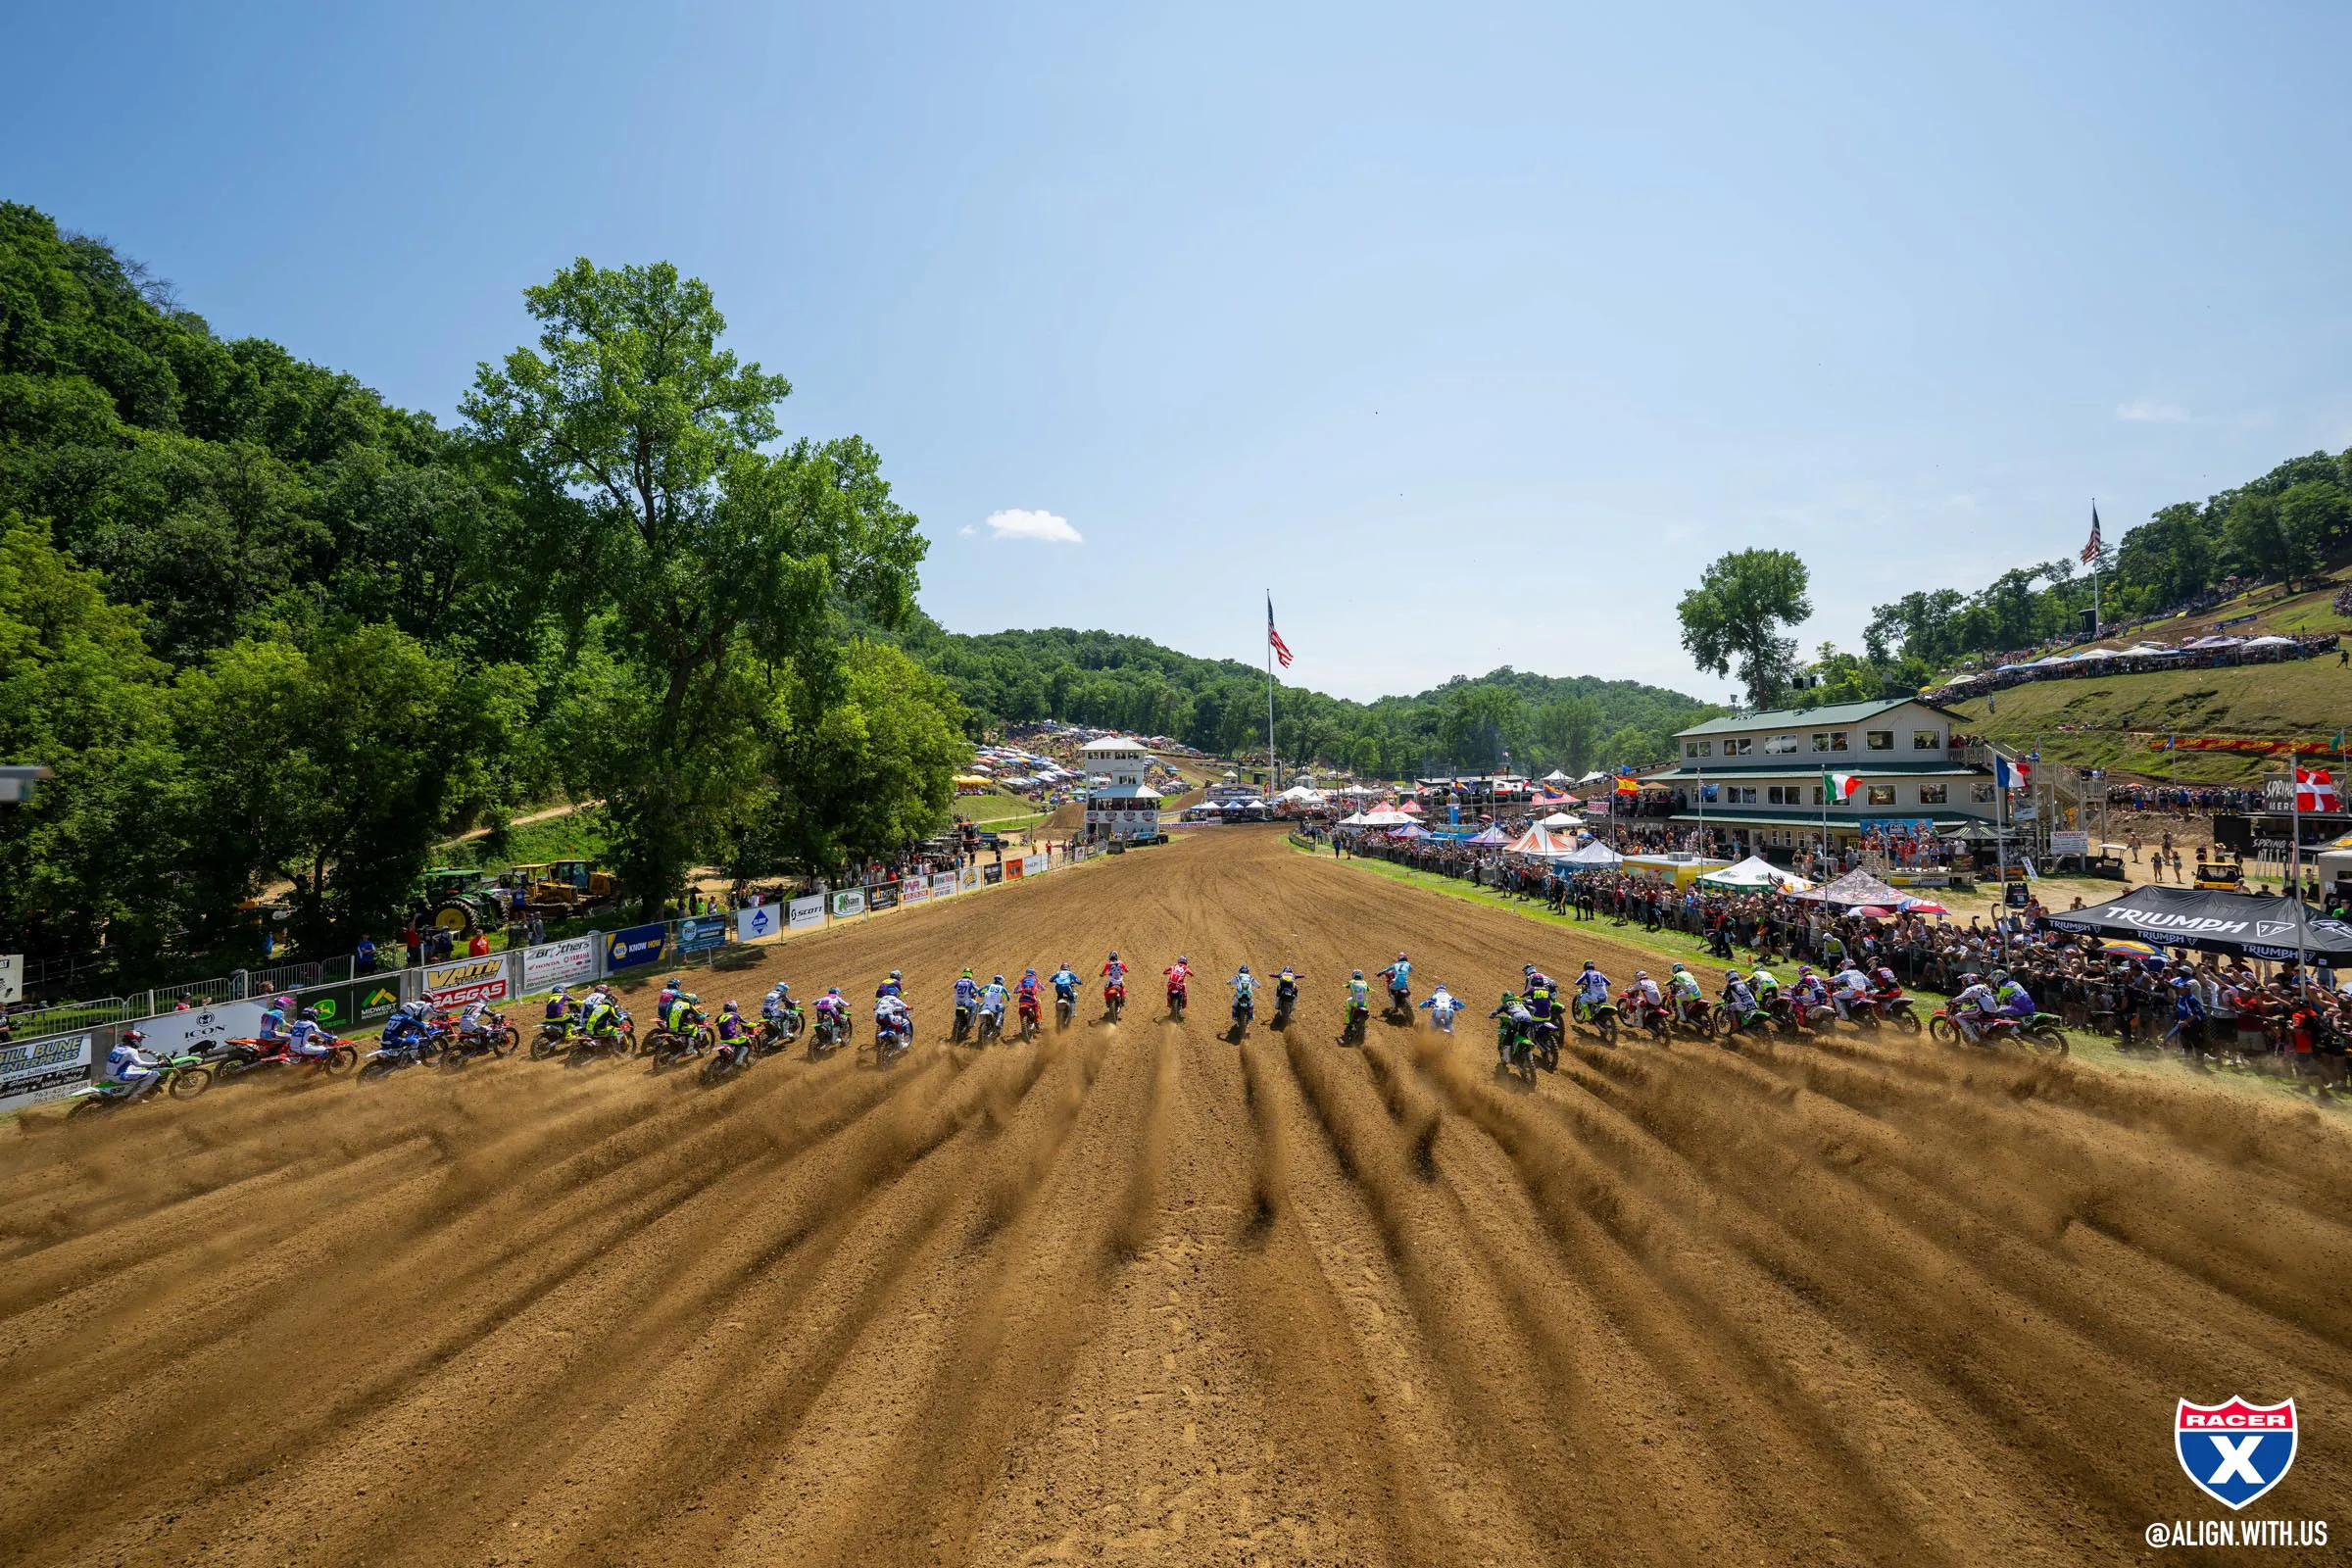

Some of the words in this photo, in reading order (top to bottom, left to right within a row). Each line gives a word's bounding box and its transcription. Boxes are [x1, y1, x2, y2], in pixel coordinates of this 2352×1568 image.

[2252, 838, 2287, 849] SPRING
[797, 906, 823, 917] SCOTT
[2048, 919, 2091, 933] TRIUMPH
[2105, 906, 2249, 933] TRIUMPH
[2137, 931, 2184, 944] TRIUMPH
[628, 942, 647, 954] KNOW
[648, 939, 662, 949] HOW
[2241, 944, 2299, 959] TRIUMPH
[535, 960, 561, 969] HONDA
[568, 952, 590, 962] YAMAHA
[427, 959, 503, 989] VAITH
[432, 983, 503, 1008] GASGAS
[361, 1003, 397, 1016] MIDWEST
[185, 1024, 227, 1039] ICON
[34, 1036, 83, 1058] BUNE
[0, 1050, 80, 1074] ENTERPRISES
[2, 1062, 77, 1081] www.billbune.com
[9, 1076, 43, 1087] Sleeving
[41, 1079, 62, 1088] Valve
